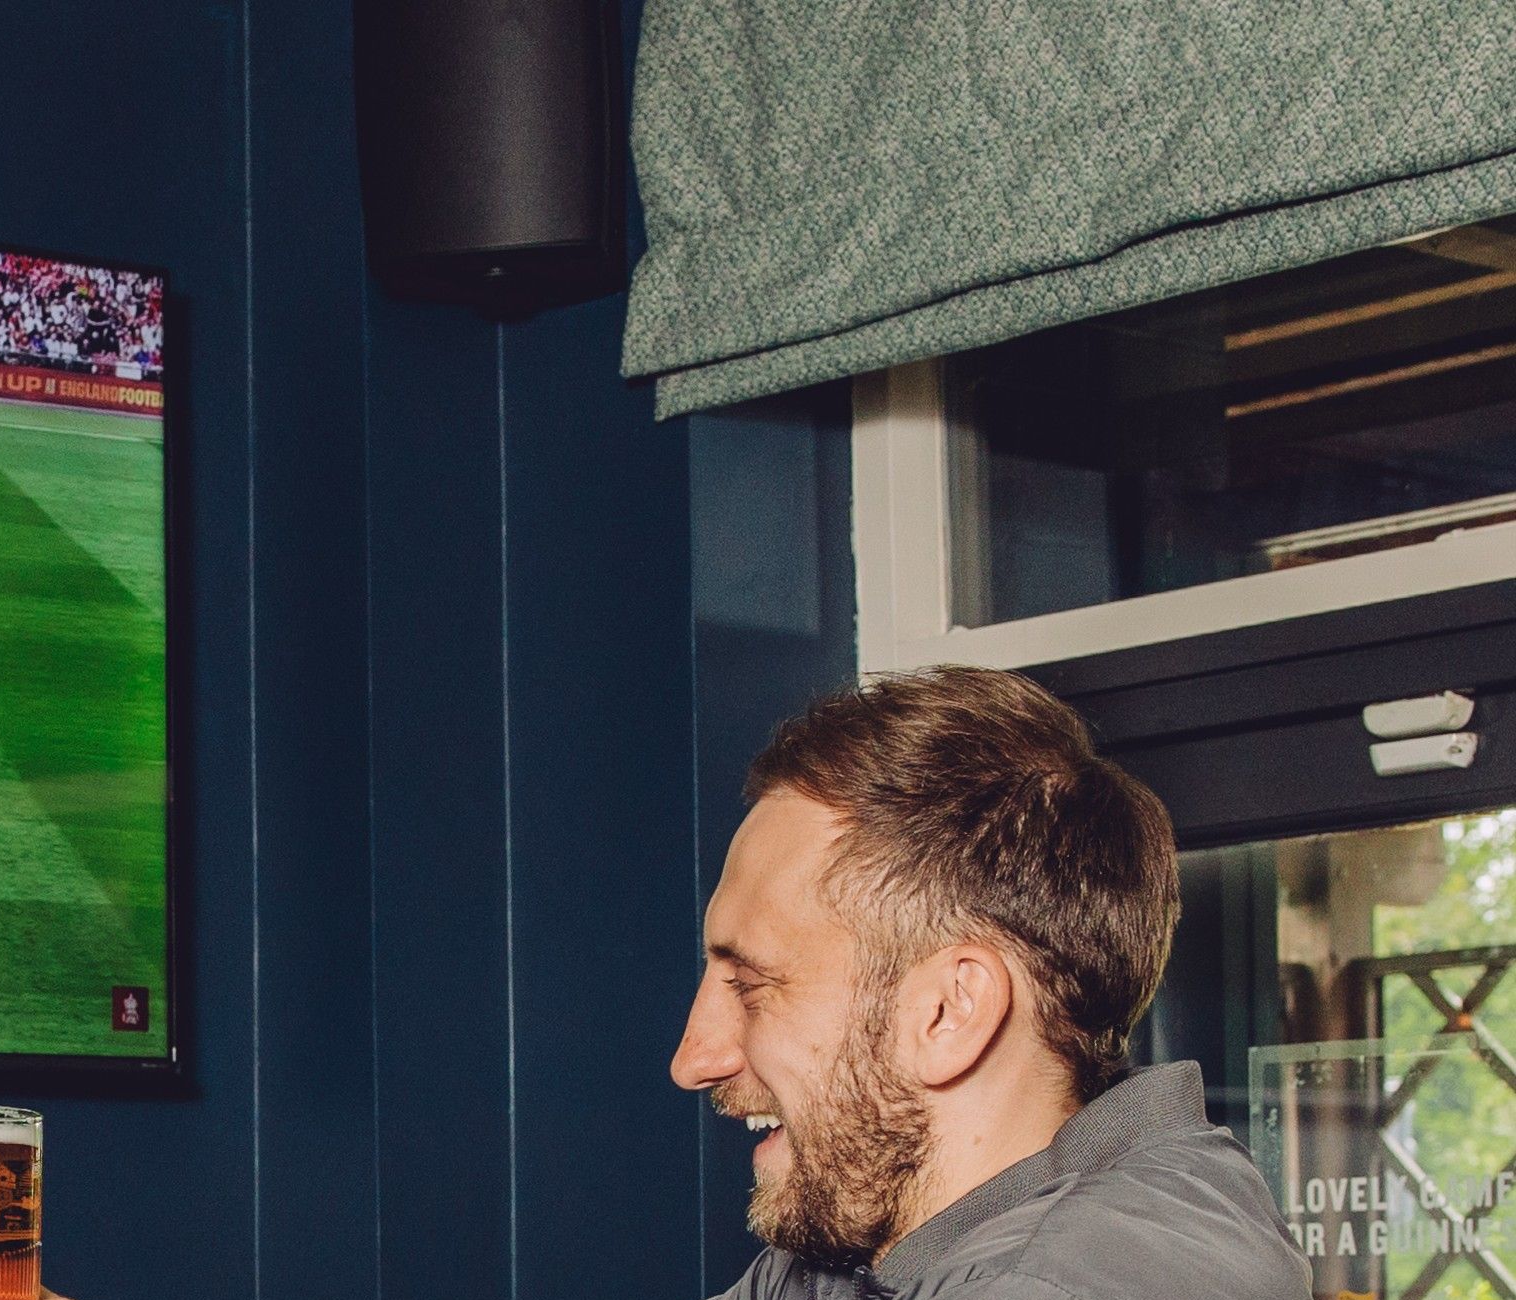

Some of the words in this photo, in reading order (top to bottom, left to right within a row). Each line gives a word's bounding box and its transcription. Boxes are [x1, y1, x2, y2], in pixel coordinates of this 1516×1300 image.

[7, 373, 42, 393] UP
[1288, 1172, 1407, 1214] LOVELY
[1419, 1171, 1515, 1209] GAME
[1337, 1221, 1357, 1256] A
